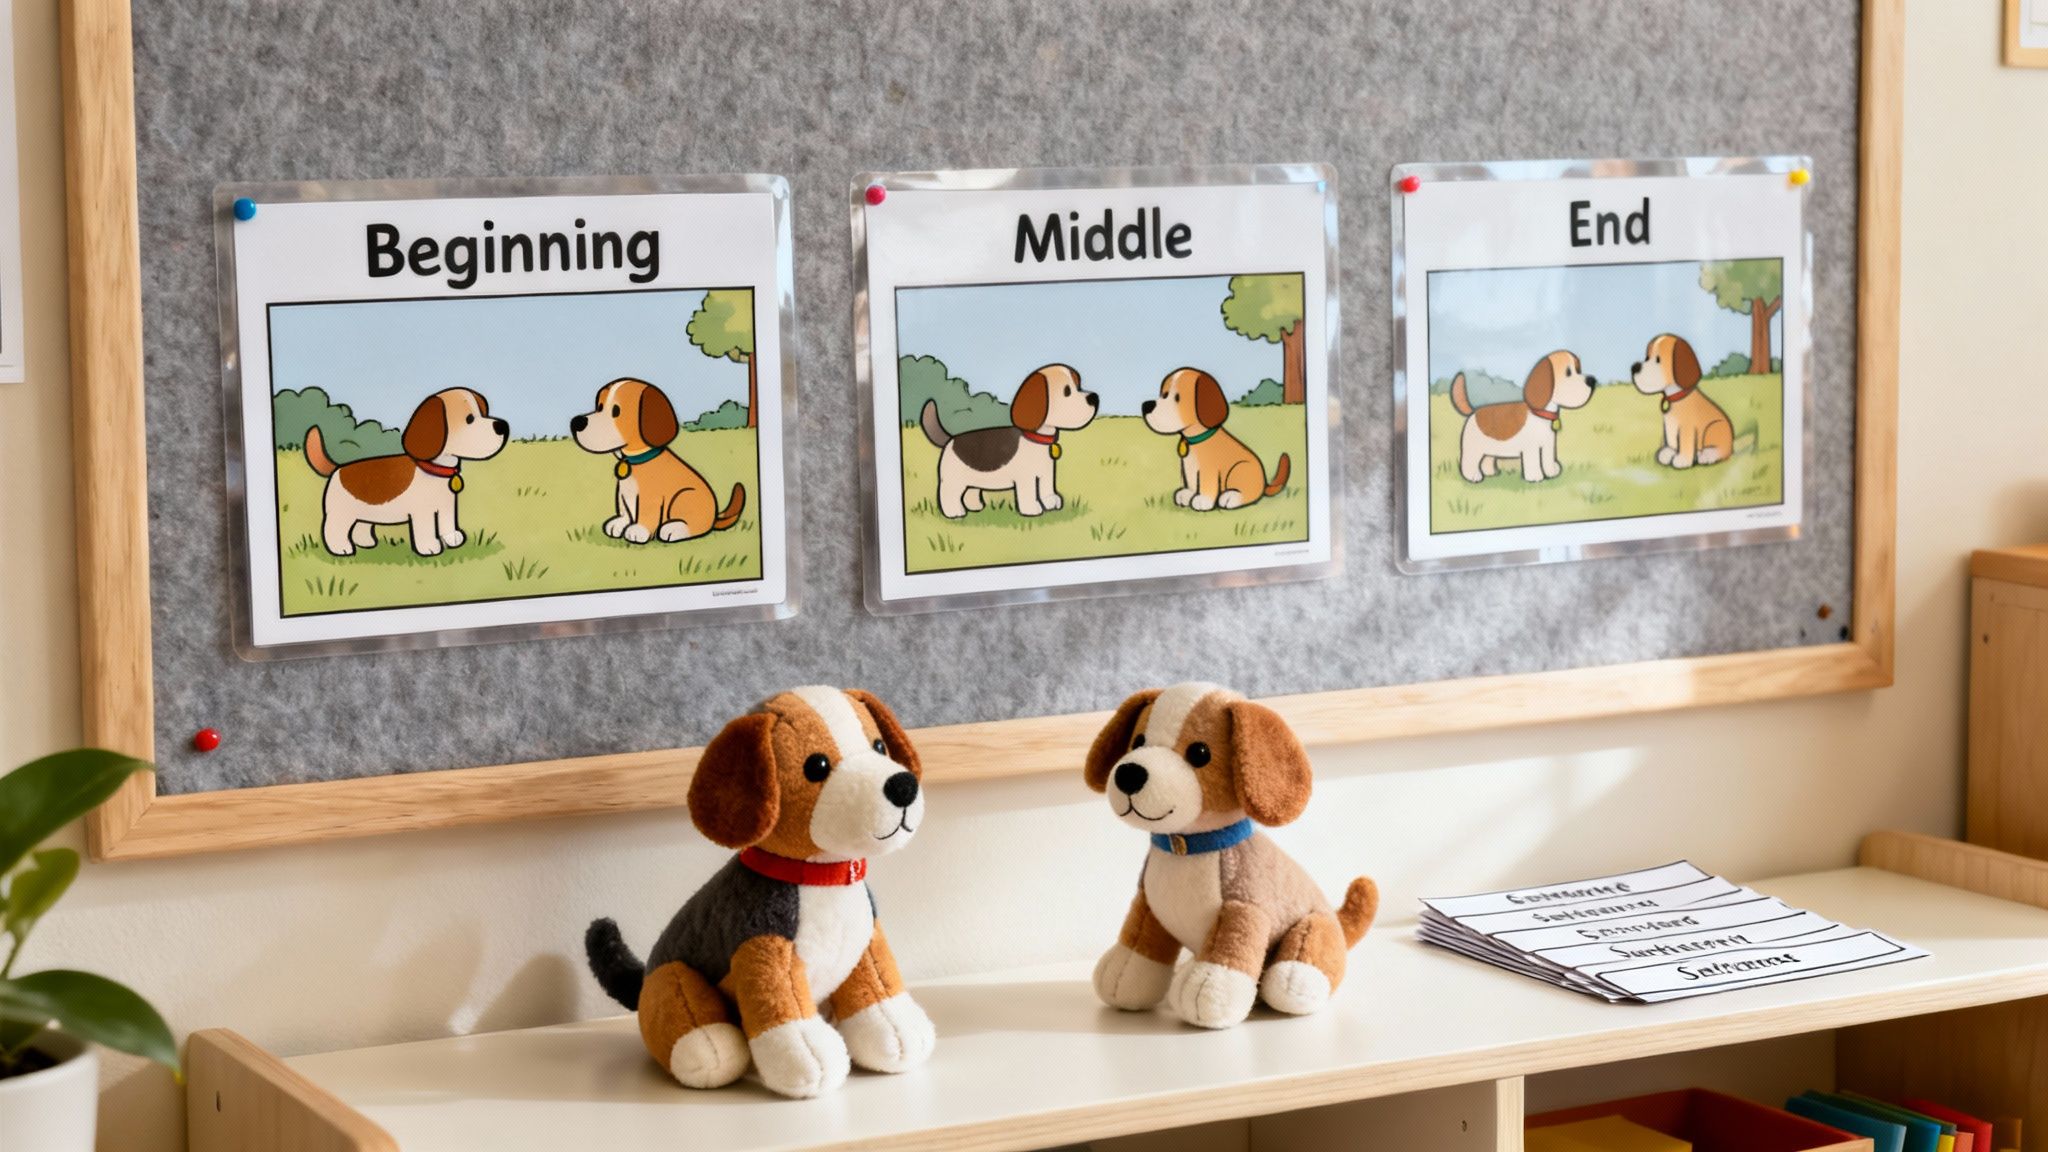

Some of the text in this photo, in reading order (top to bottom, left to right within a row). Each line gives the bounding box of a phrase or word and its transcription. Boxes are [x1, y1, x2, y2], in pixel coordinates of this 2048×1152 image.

[1014, 206, 1193, 263] Middle
[1570, 197, 1650, 247] End
[366, 218, 660, 290] Beginning
